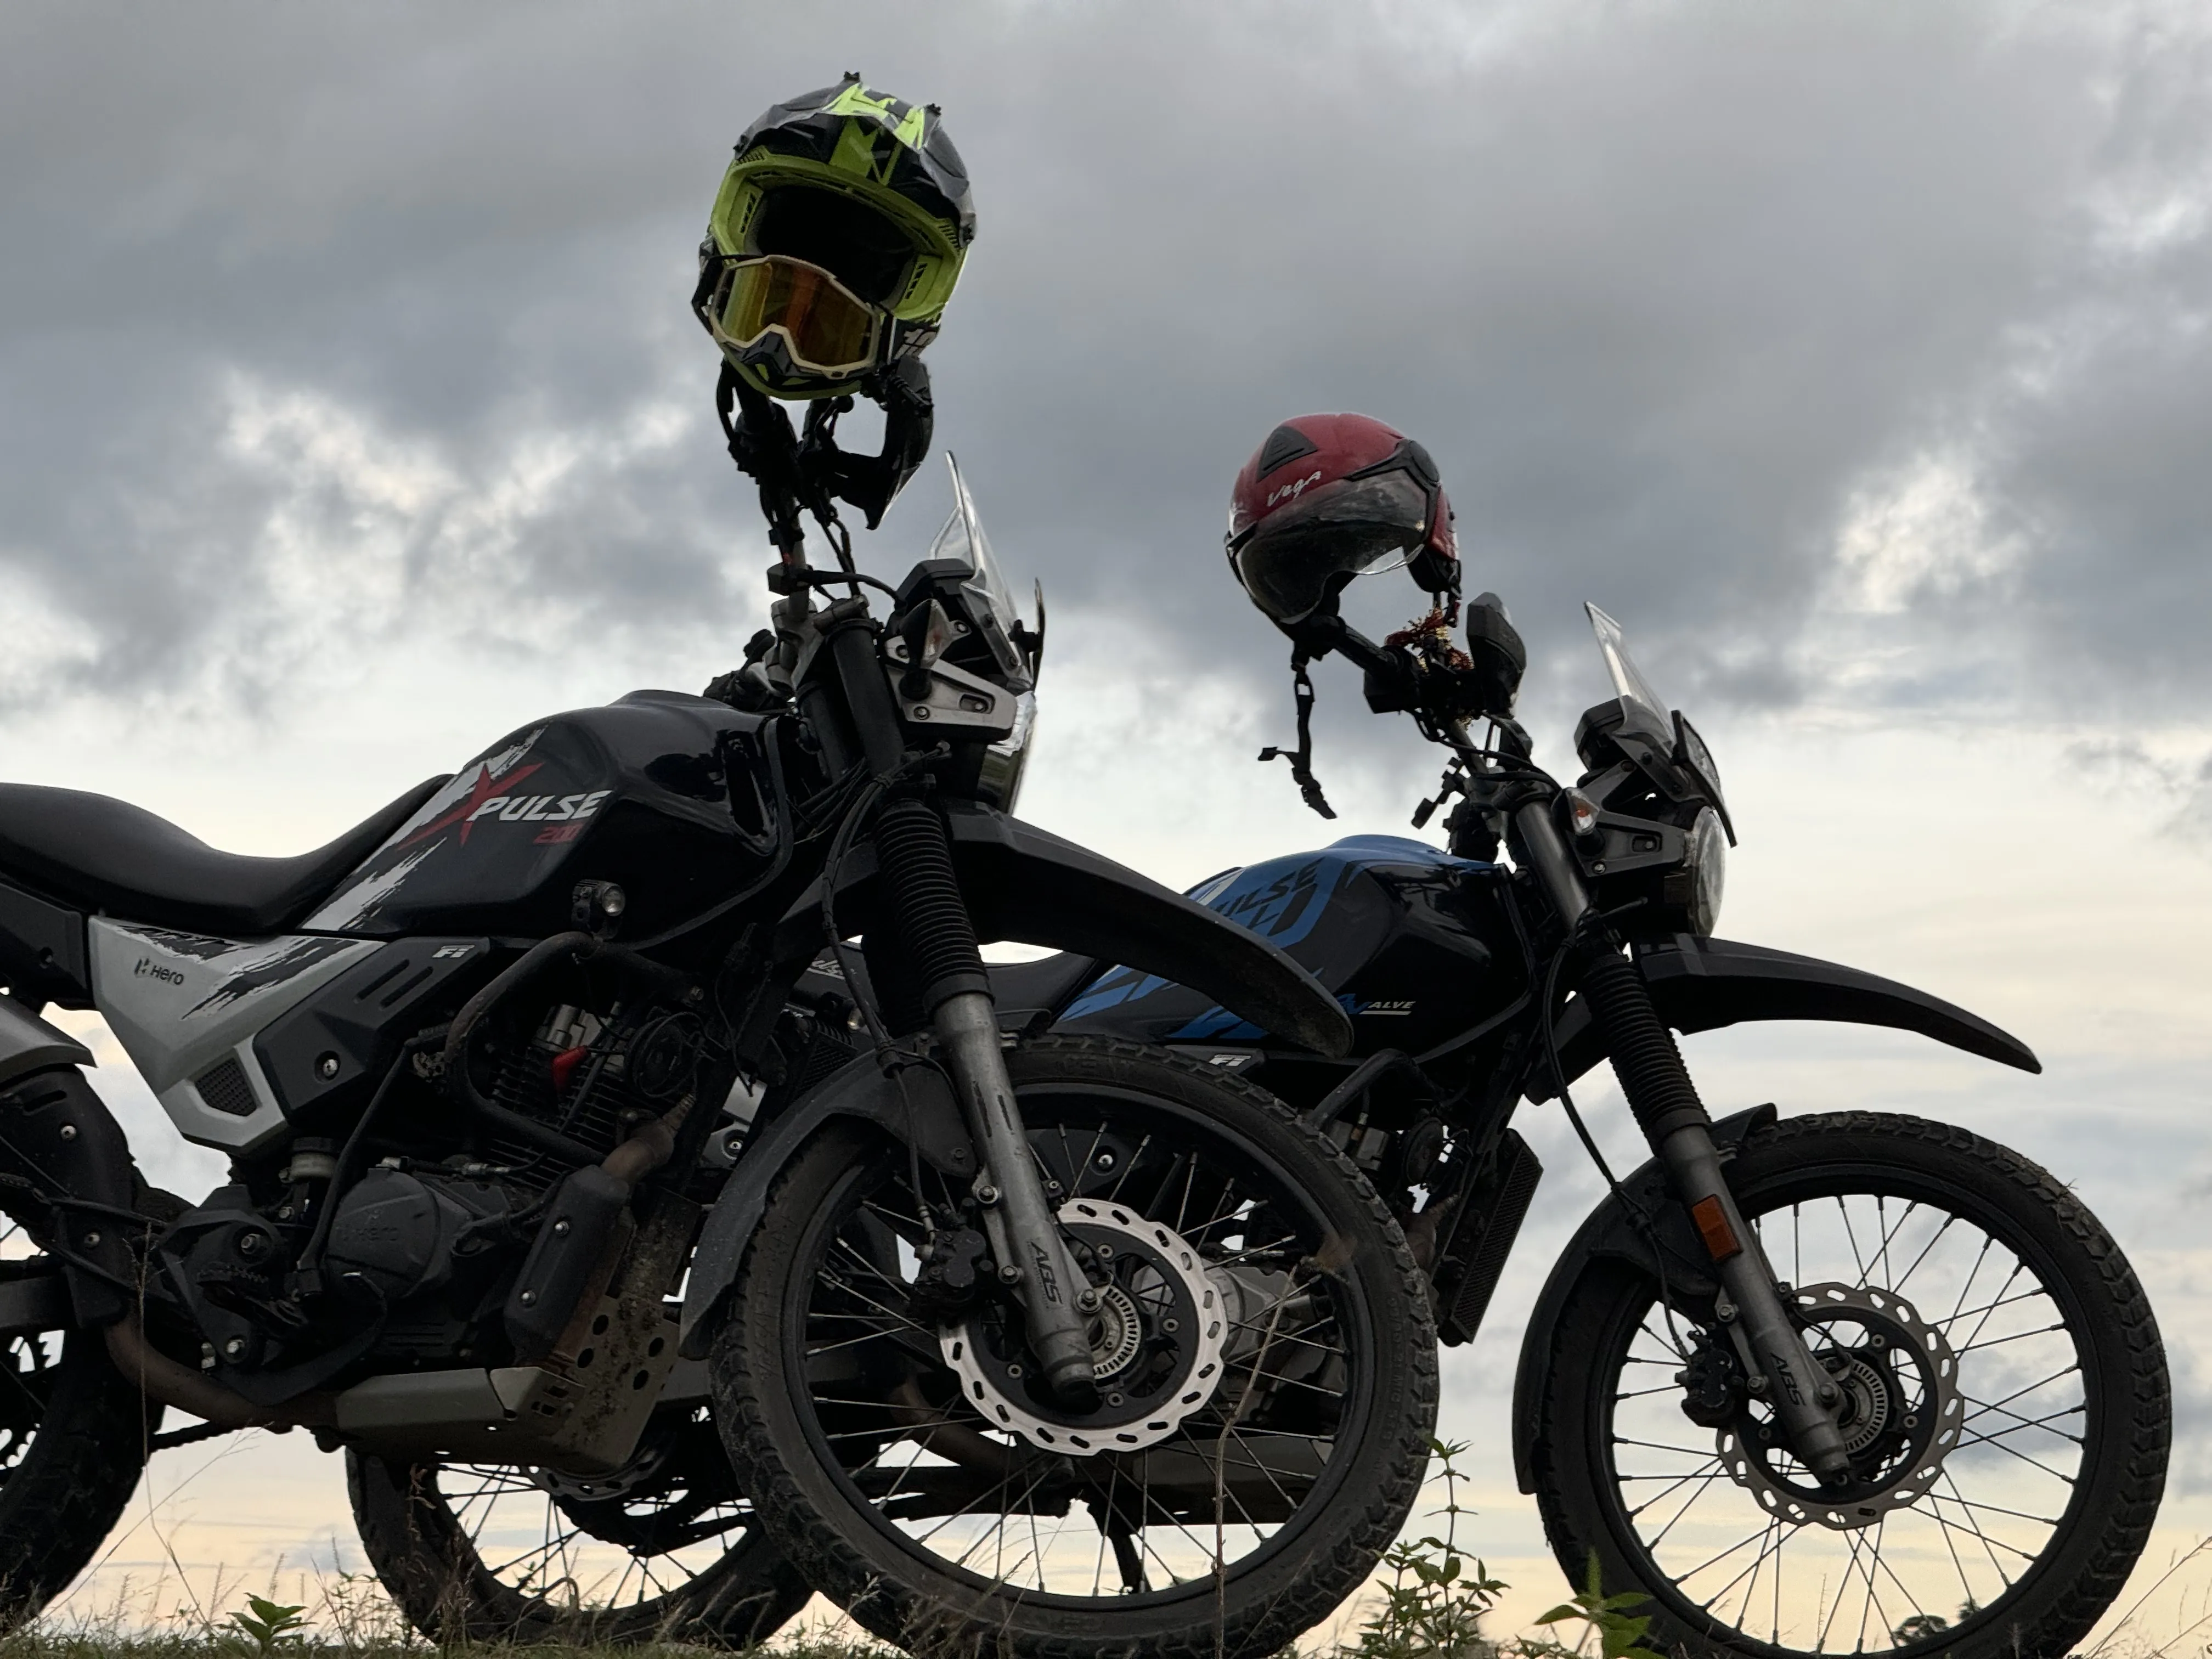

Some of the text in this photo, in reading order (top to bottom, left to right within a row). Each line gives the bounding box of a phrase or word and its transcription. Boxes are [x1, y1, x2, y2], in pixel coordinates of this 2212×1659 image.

[150, 965, 184, 985] Hero
[1031, 1241, 1063, 1304] ABS
[1770, 1352, 1806, 1406] ABS
